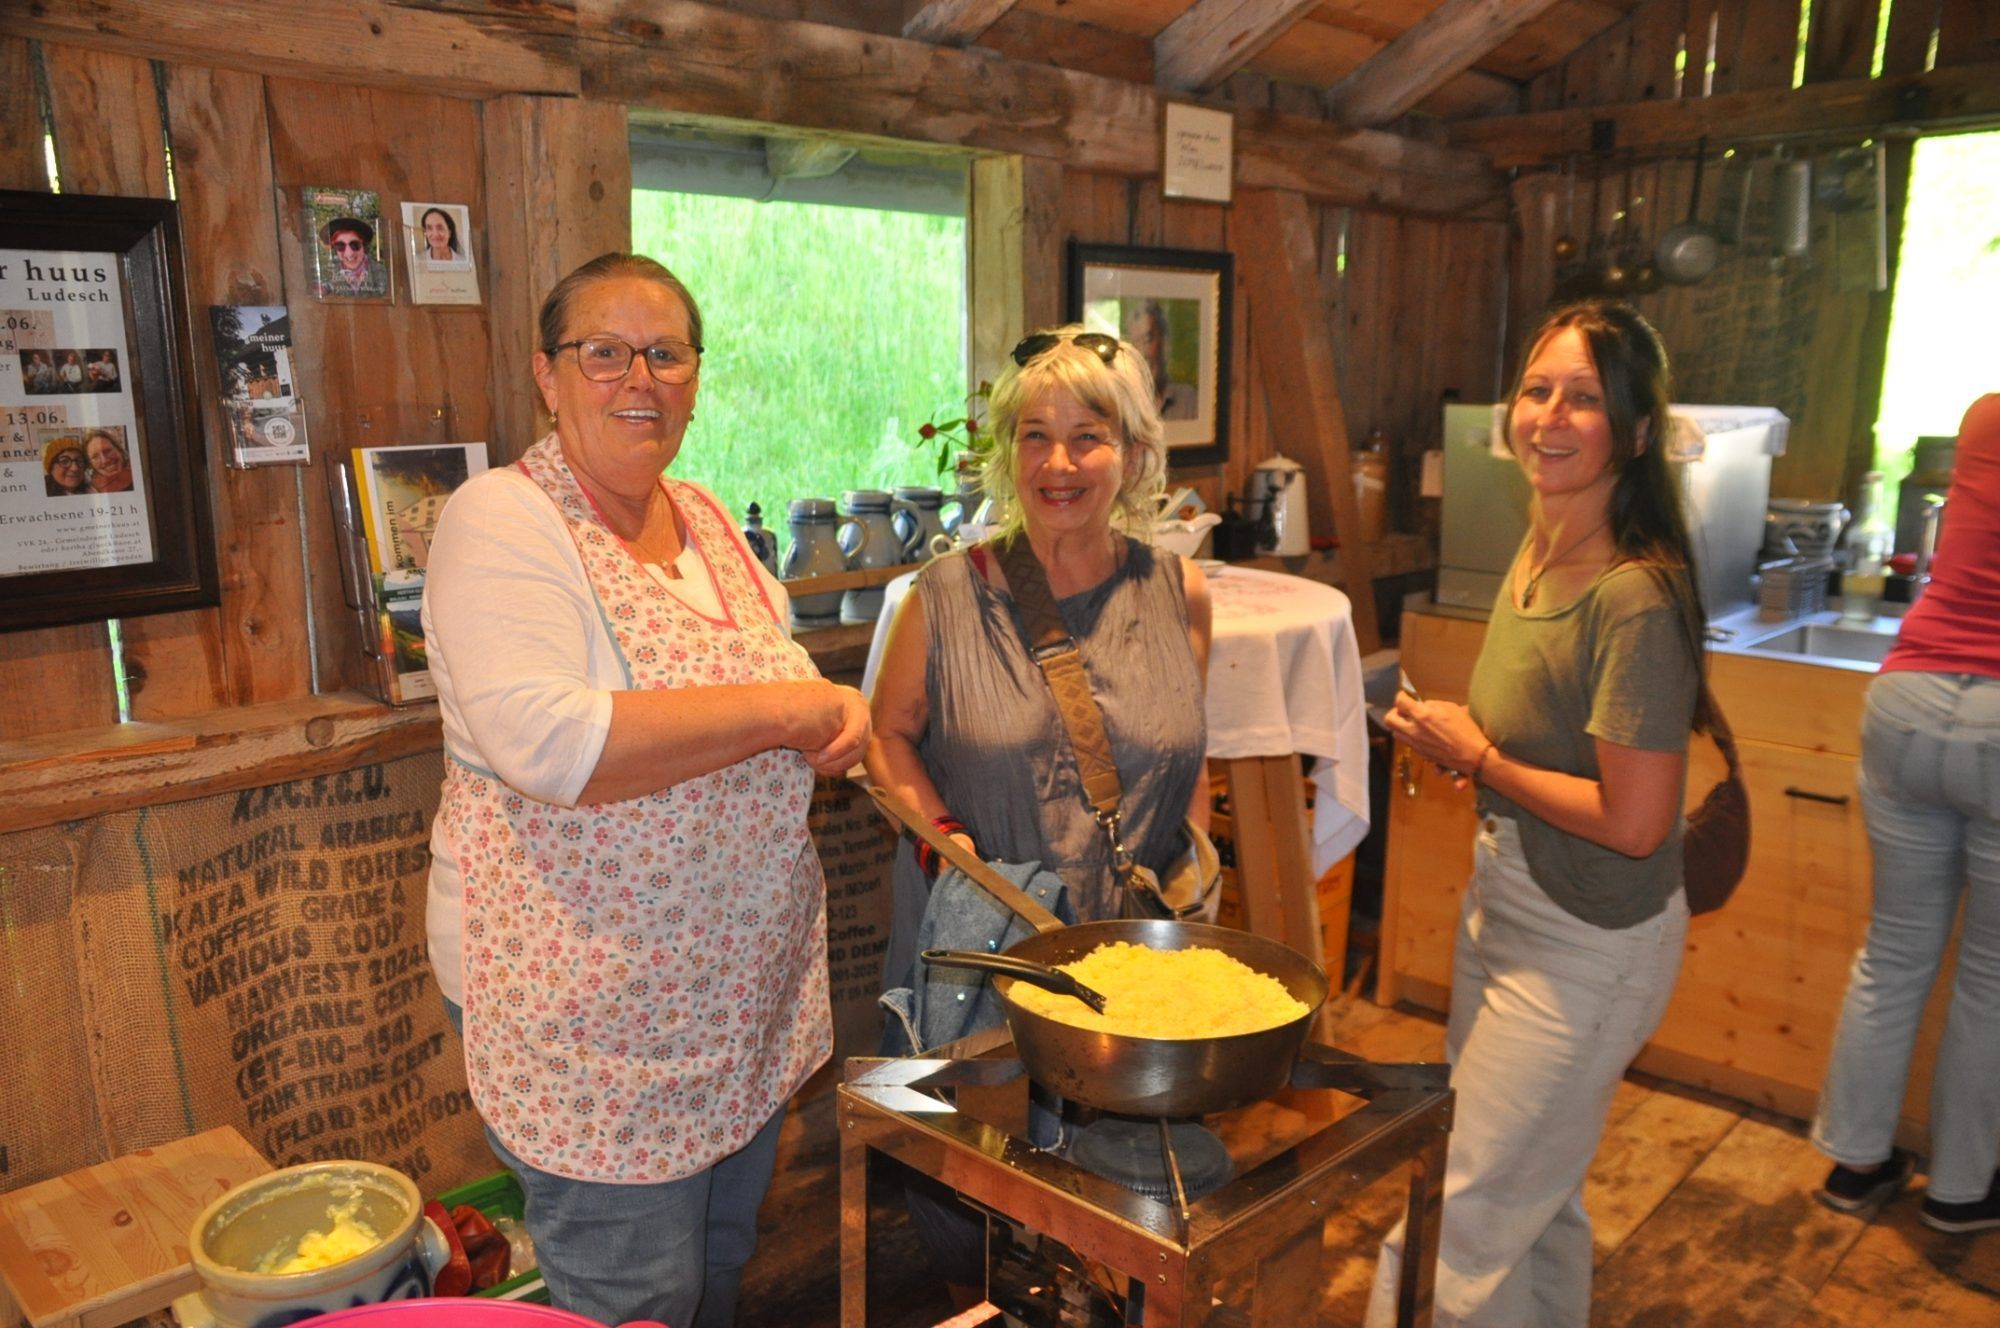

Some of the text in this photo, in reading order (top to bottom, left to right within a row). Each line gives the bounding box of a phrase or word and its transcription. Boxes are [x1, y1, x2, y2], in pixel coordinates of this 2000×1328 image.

[23, 258, 107, 283] huus
[26, 287, 110, 302] Ludesch
[6, 411, 66, 426] 13.06.
[0, 510, 84, 525] Erwachsene
[130, 504, 139, 515] h
[178, 809, 426, 897] NATURAL ARABICA
[161, 882, 247, 945] KAFA
[254, 857, 330, 898] WILD
[181, 902, 280, 971] COFFEE
[301, 887, 388, 923] GRADE
[828, 923, 876, 941] Coffee
[185, 911, 406, 1008] VARIOUS COOP
[828, 946, 847, 962] ND
[226, 962, 360, 1030] HARVEST
[231, 970, 430, 1063] ORGANIC CERT
[391, 1031, 446, 1078] CERT
